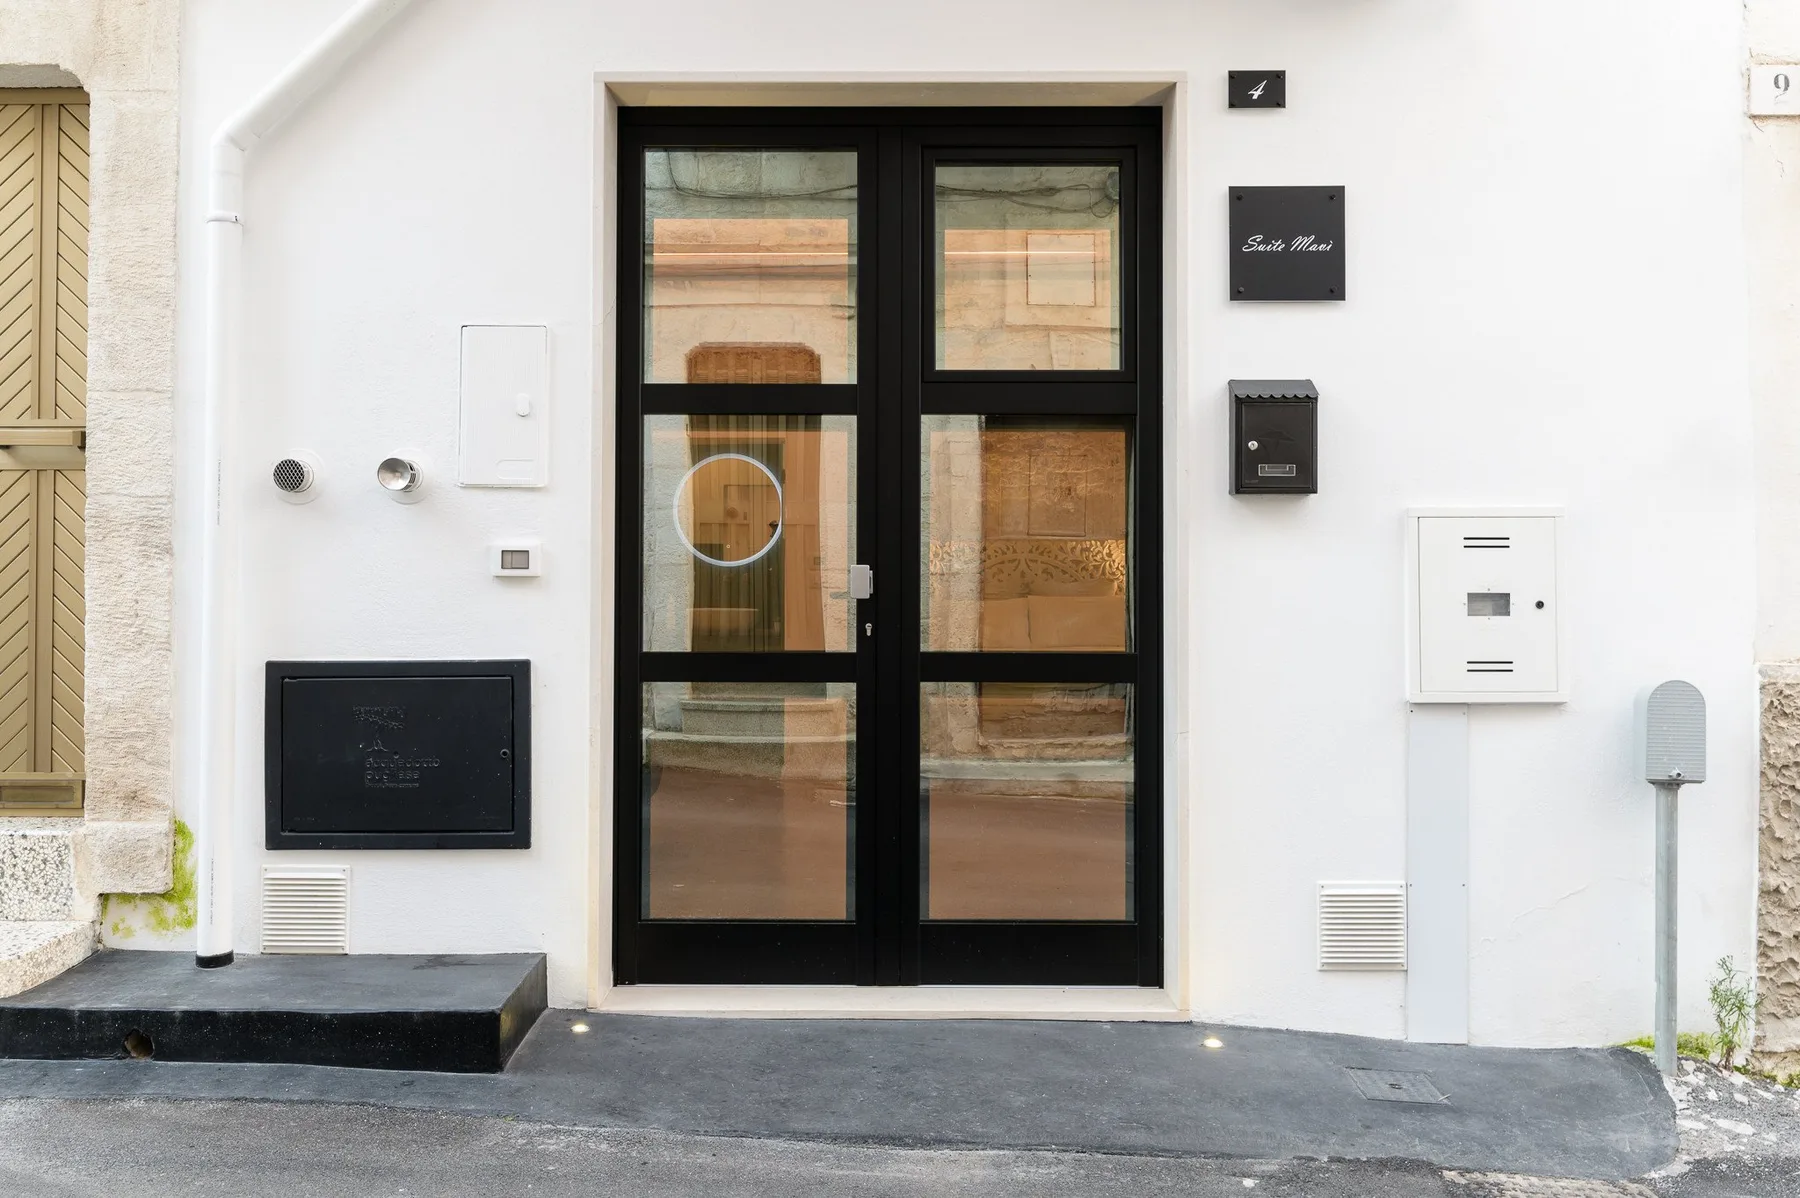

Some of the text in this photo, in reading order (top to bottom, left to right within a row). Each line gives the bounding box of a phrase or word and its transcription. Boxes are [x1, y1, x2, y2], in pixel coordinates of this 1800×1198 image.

[1247, 79, 1267, 100] 4
[1773, 73, 1790, 100] 9
[1242, 234, 1286, 252] Suite
